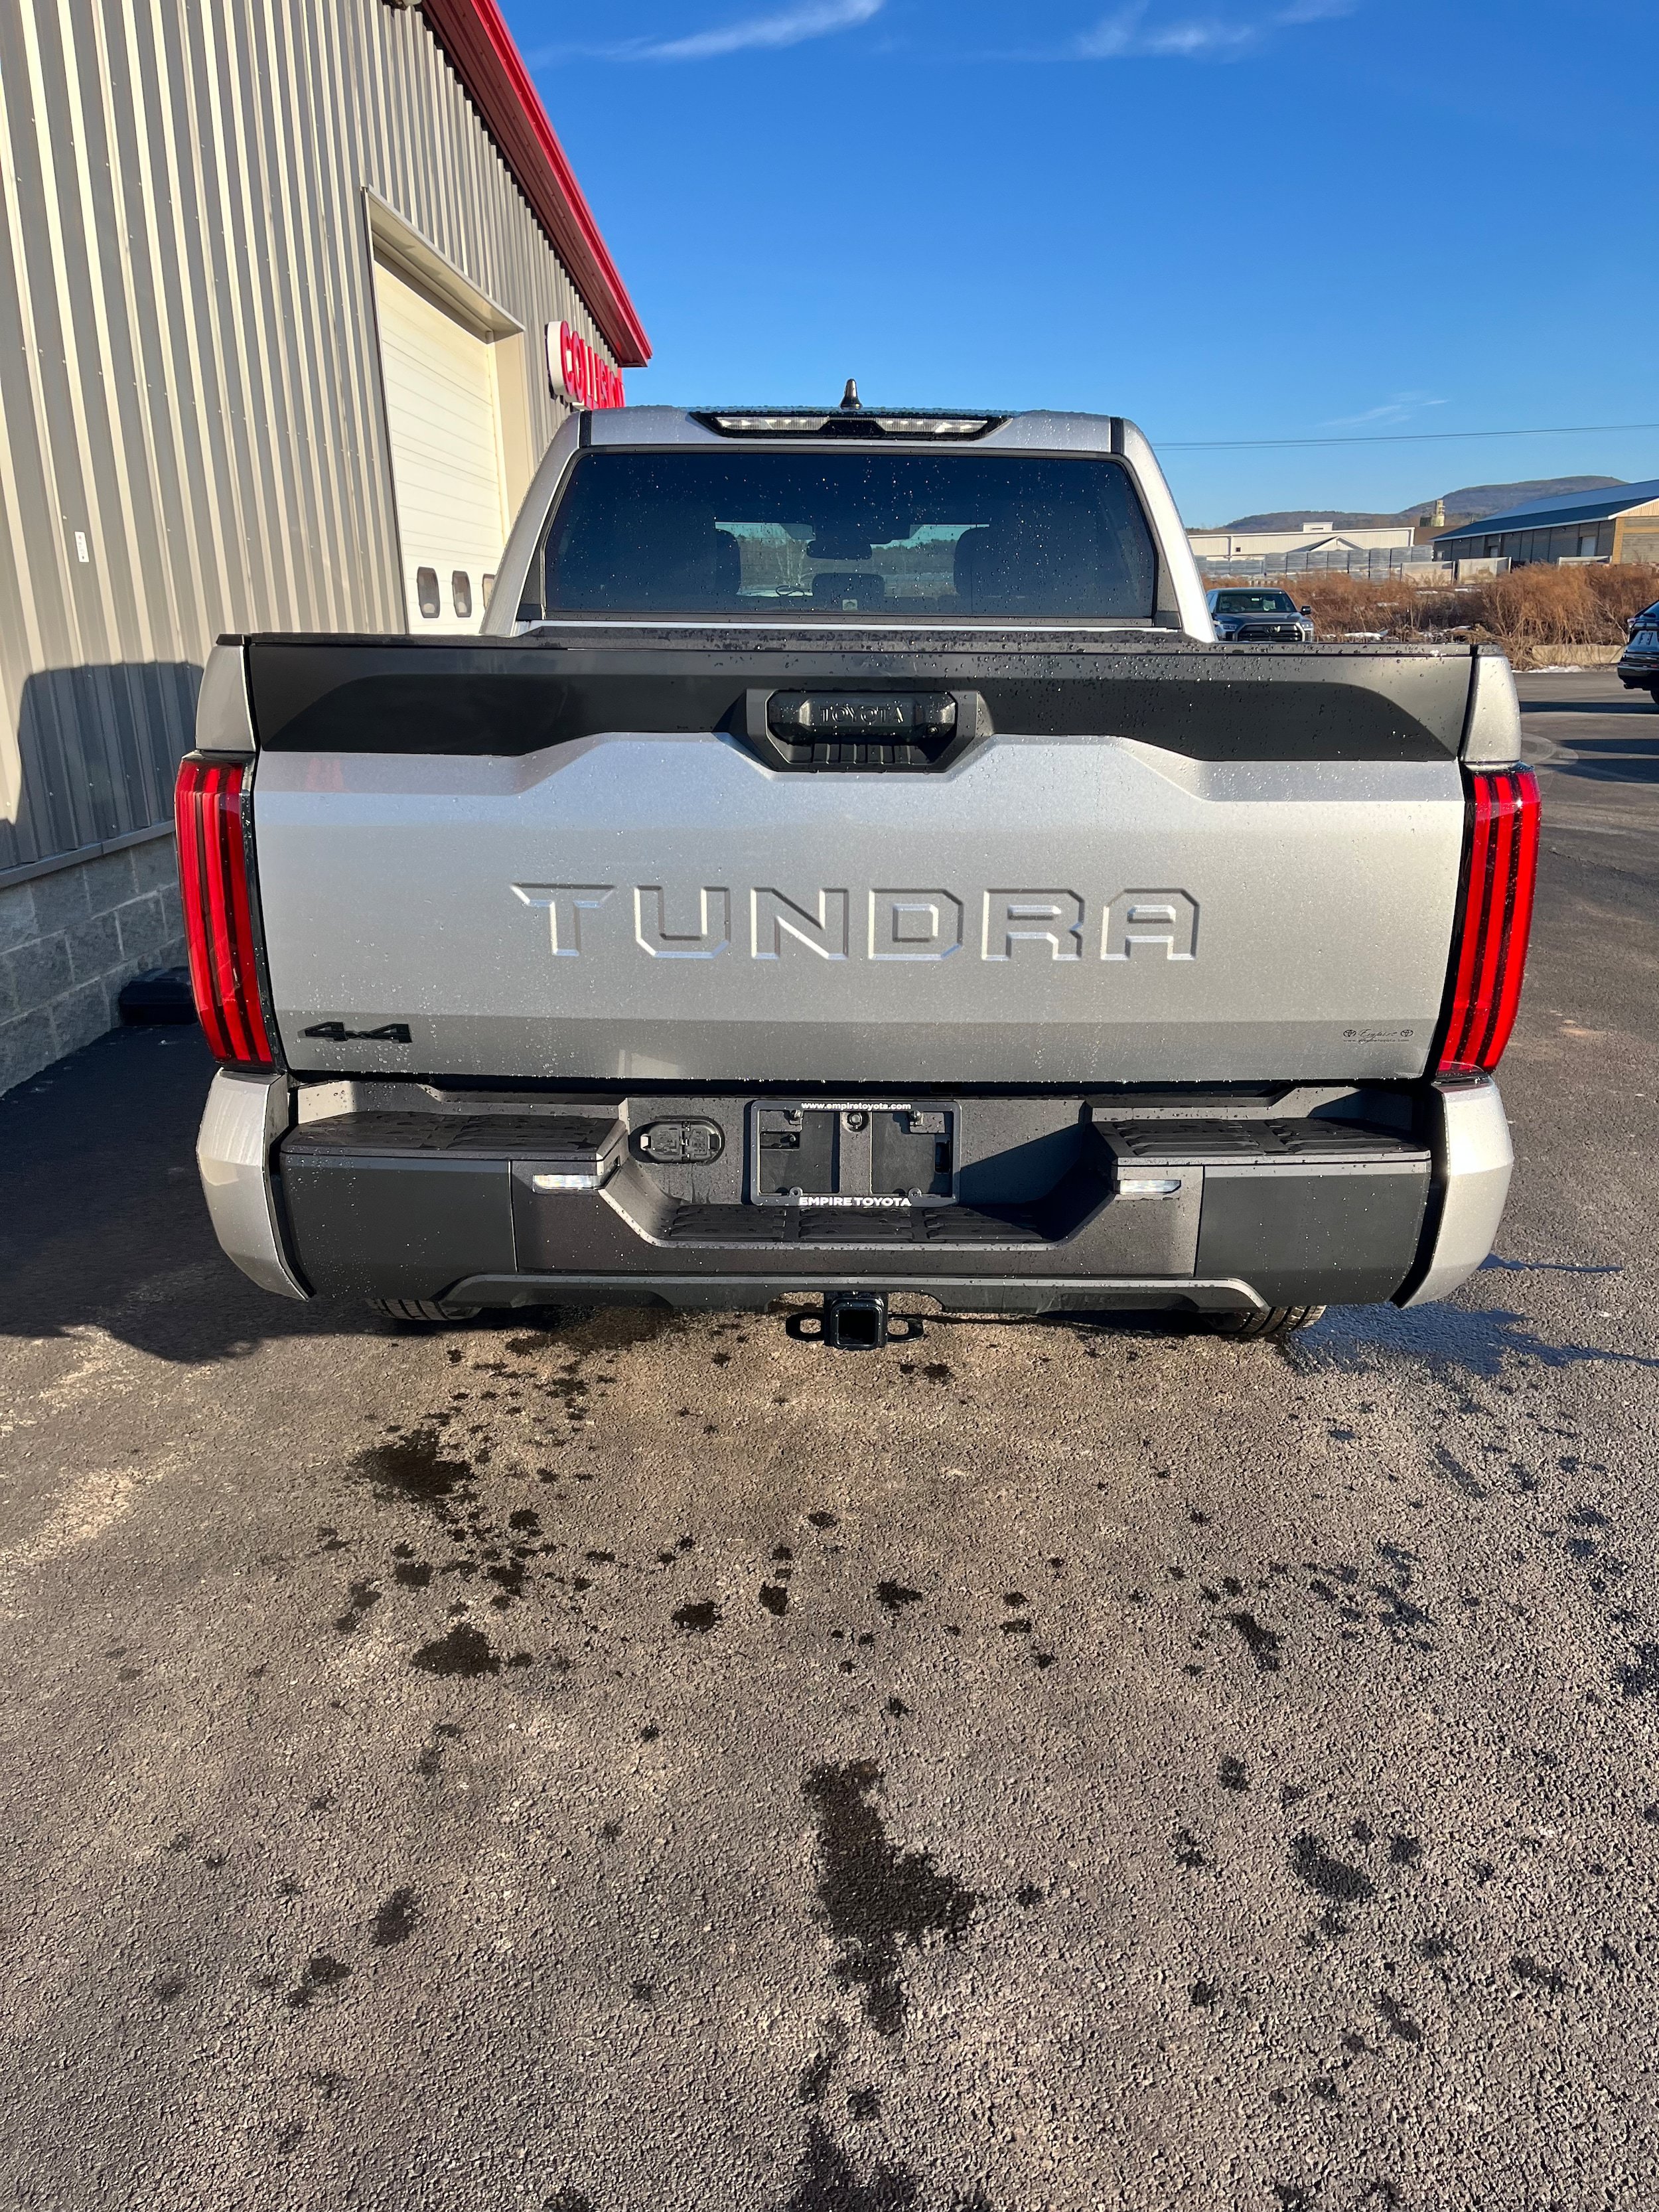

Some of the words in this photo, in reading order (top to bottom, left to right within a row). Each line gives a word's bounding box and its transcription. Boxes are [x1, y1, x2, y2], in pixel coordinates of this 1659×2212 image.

[818, 705, 904, 723] TOYOTA
[510, 883, 1200, 960] TUNDRA
[801, 1102, 912, 1111] www.empiretoyota.com
[798, 1197, 853, 1207] EMPIRE
[854, 1197, 912, 1207] TOYOTA
